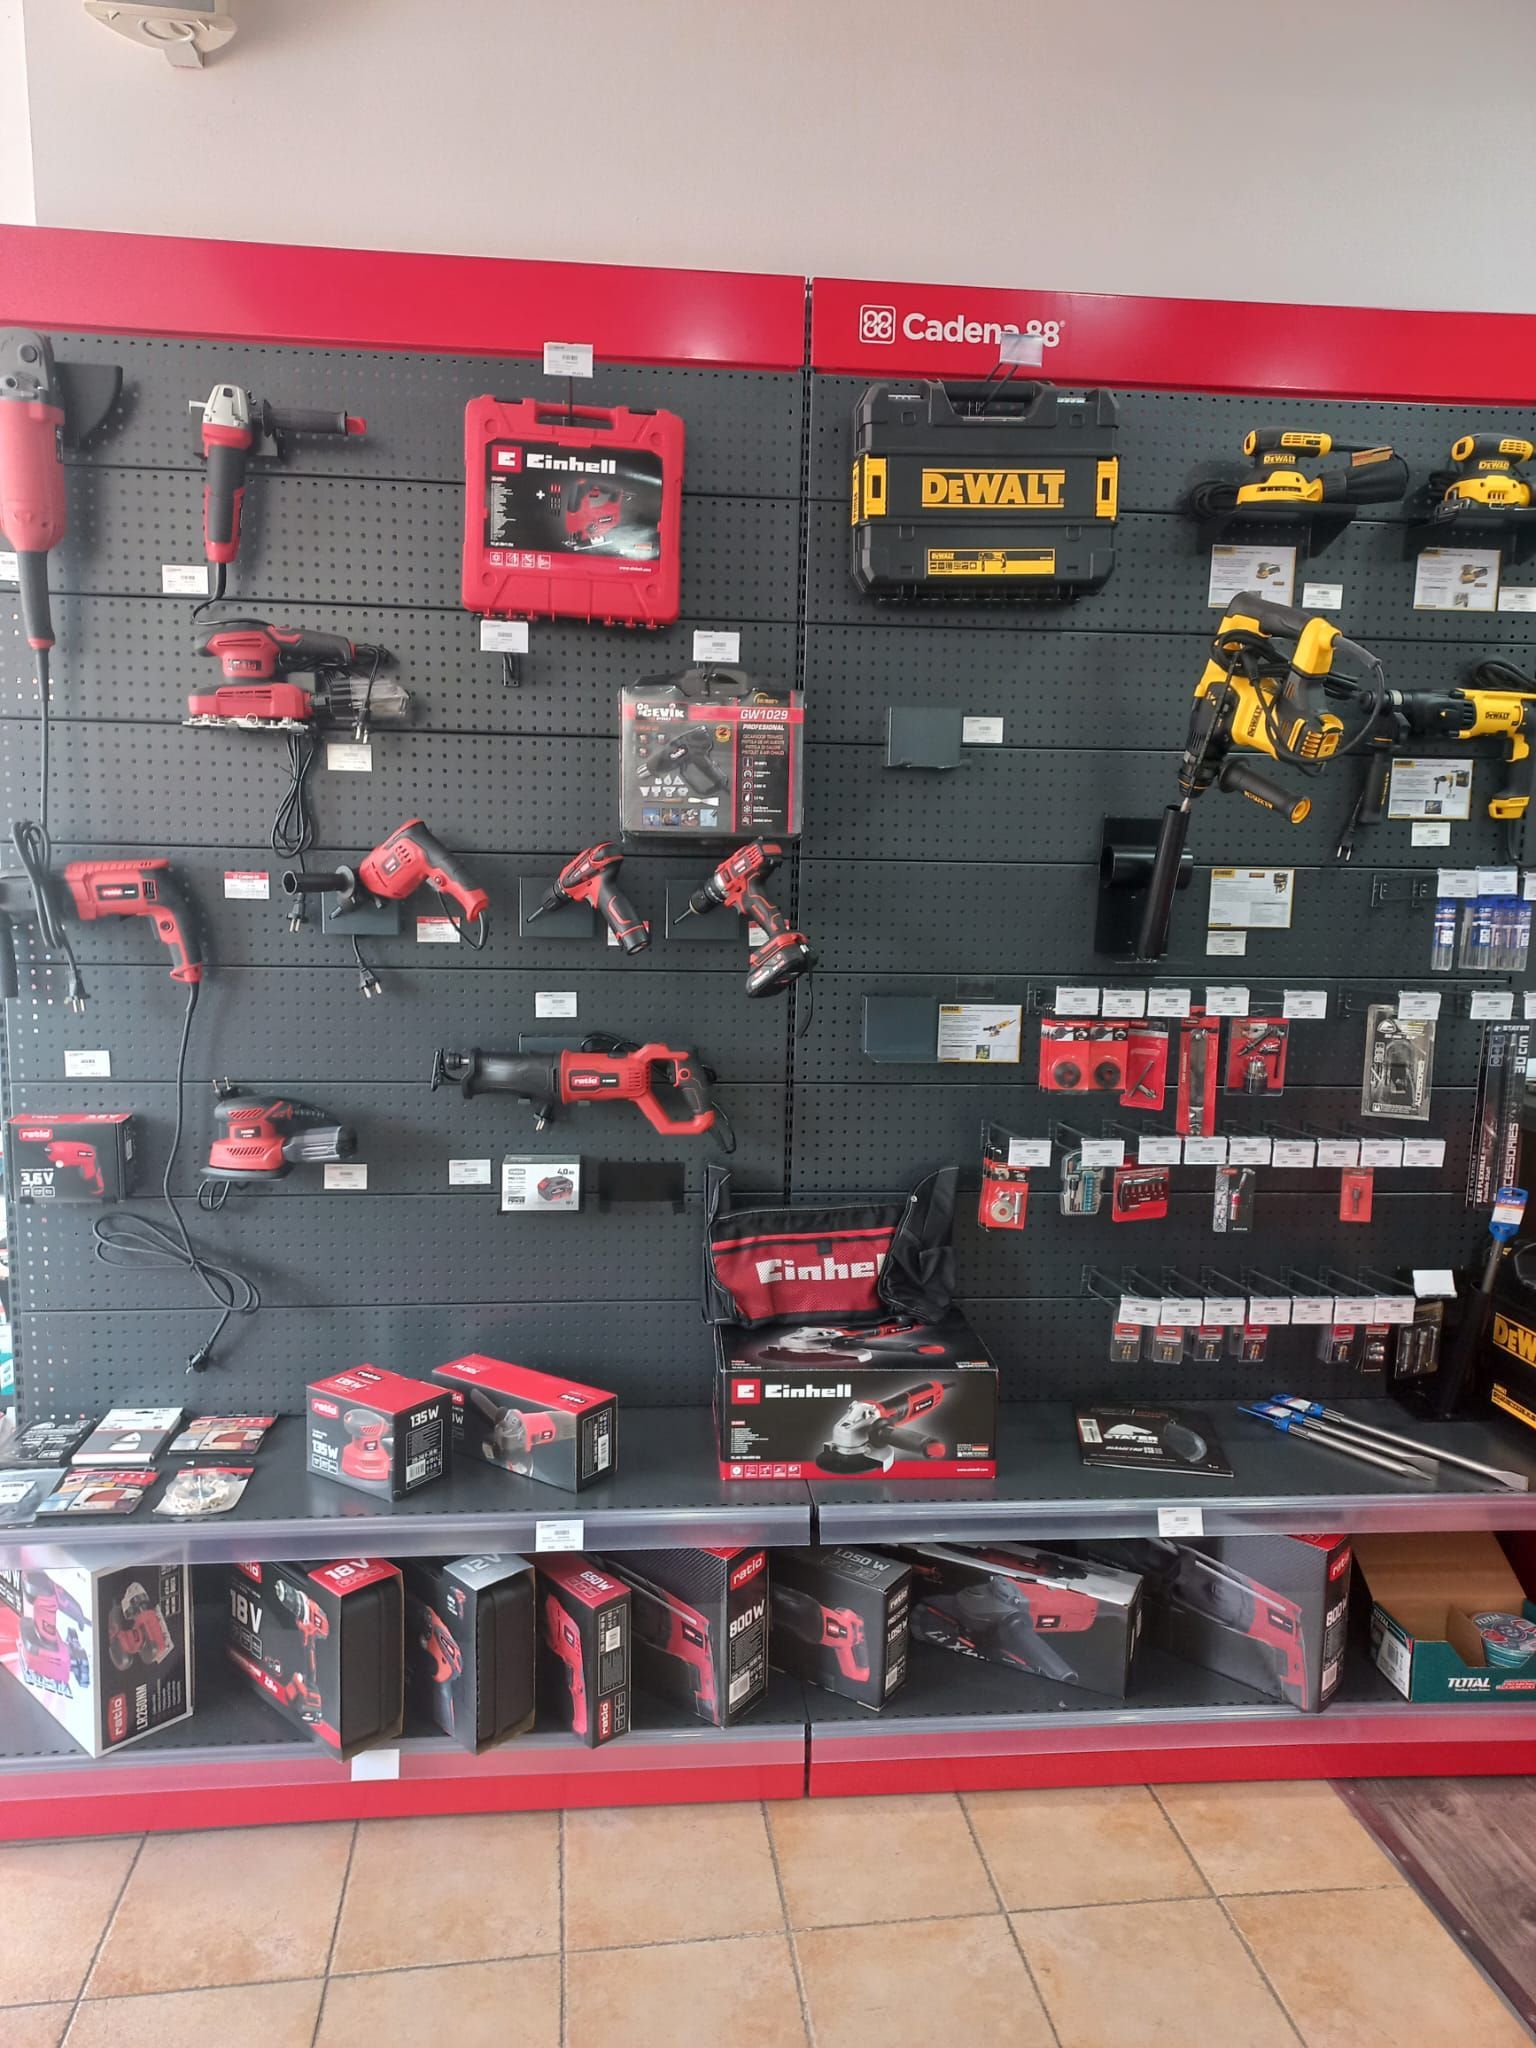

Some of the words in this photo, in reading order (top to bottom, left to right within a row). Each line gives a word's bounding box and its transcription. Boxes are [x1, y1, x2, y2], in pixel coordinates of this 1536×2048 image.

[526, 453, 616, 474] Einhell
[740, 709, 788, 720] GW1029
[22, 1130, 50, 1138] ratio
[21, 1172, 54, 1188] 3,6V
[756, 1253, 886, 1284] Einhel
[765, 1384, 851, 1398] Einhell
[313, 1403, 336, 1415] ratio
[312, 1440, 338, 1459] 135W
[734, 1558, 763, 1585] ratio
[872, 1560, 890, 1571] W
[580, 1570, 615, 1591] 650W
[890, 1588, 909, 1609] ratio
[230, 1589, 262, 1633] 18V
[730, 1599, 765, 1638] 800W
[1475, 1614, 1503, 1626] TOTAL
[1448, 1677, 1491, 1688] TOTAL
[113, 1698, 123, 1736] ratio
[136, 1684, 148, 1730] LR260NM
